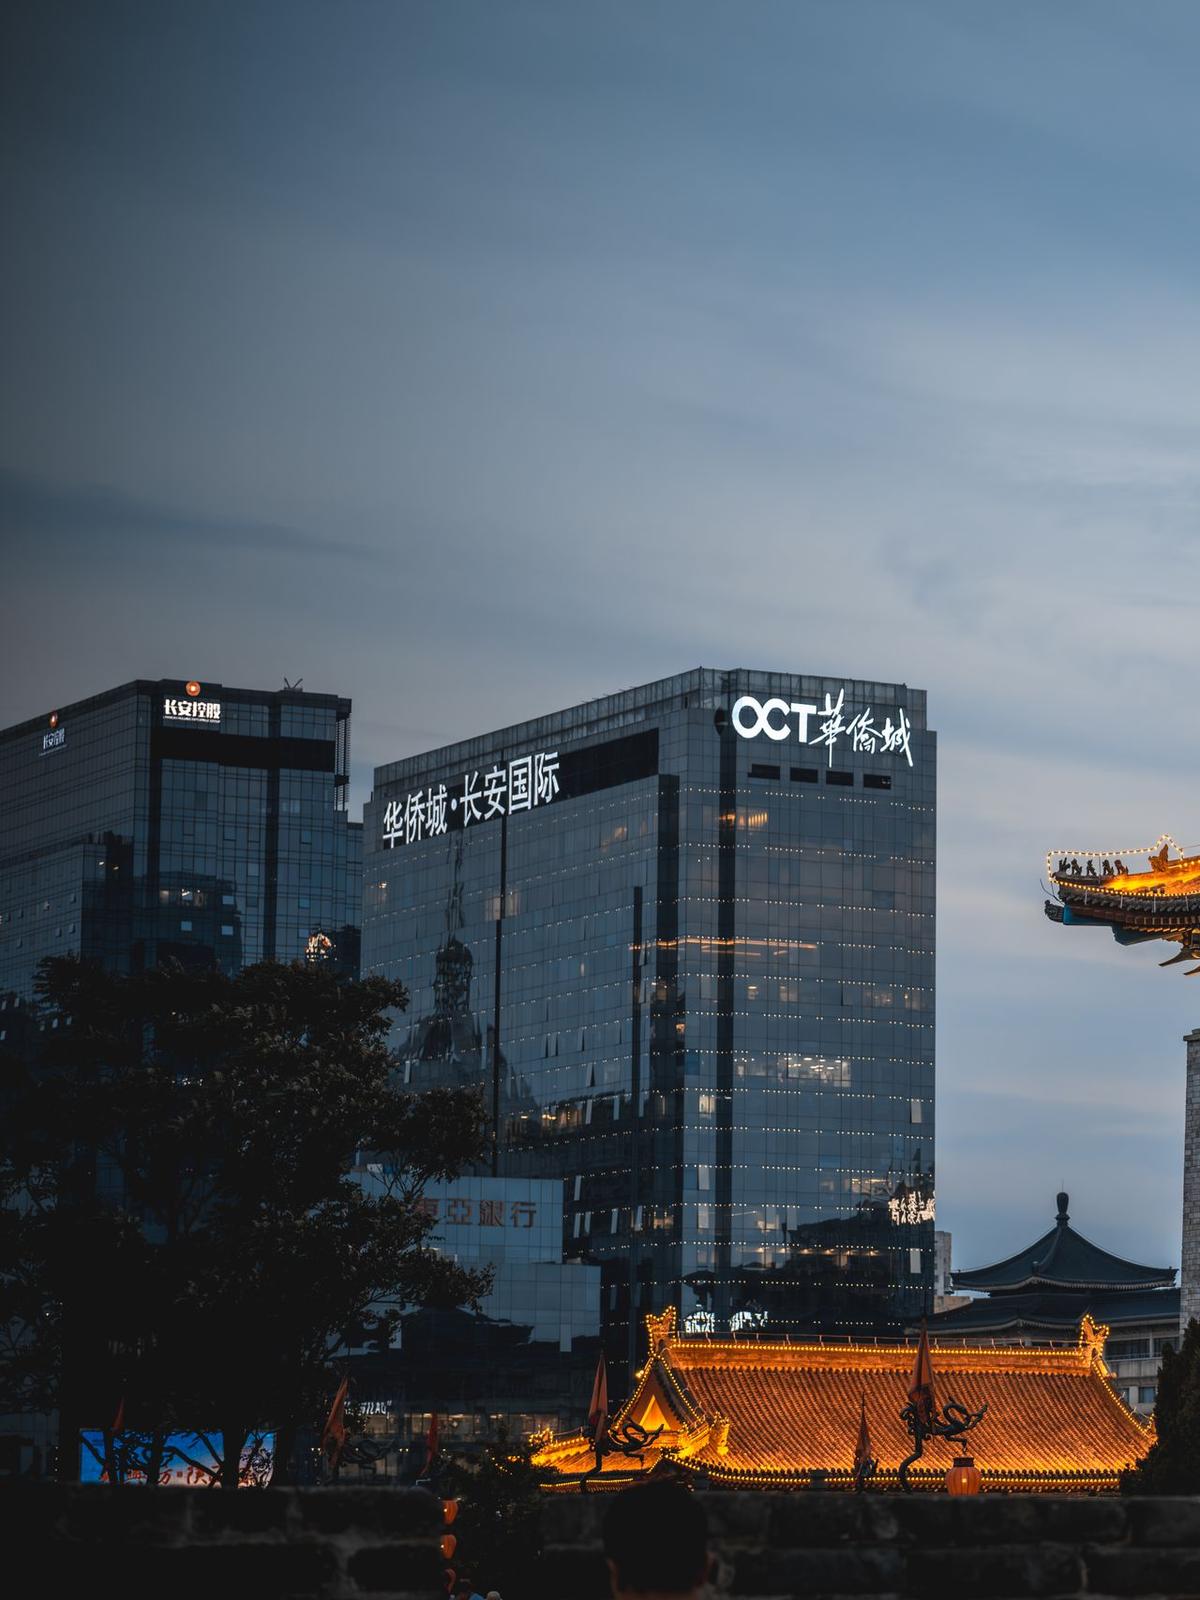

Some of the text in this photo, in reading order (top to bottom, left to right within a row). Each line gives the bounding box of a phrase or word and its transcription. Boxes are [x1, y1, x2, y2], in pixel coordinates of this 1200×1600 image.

[164, 698, 221, 719] 长安控股
[732, 695, 817, 743] OCT
